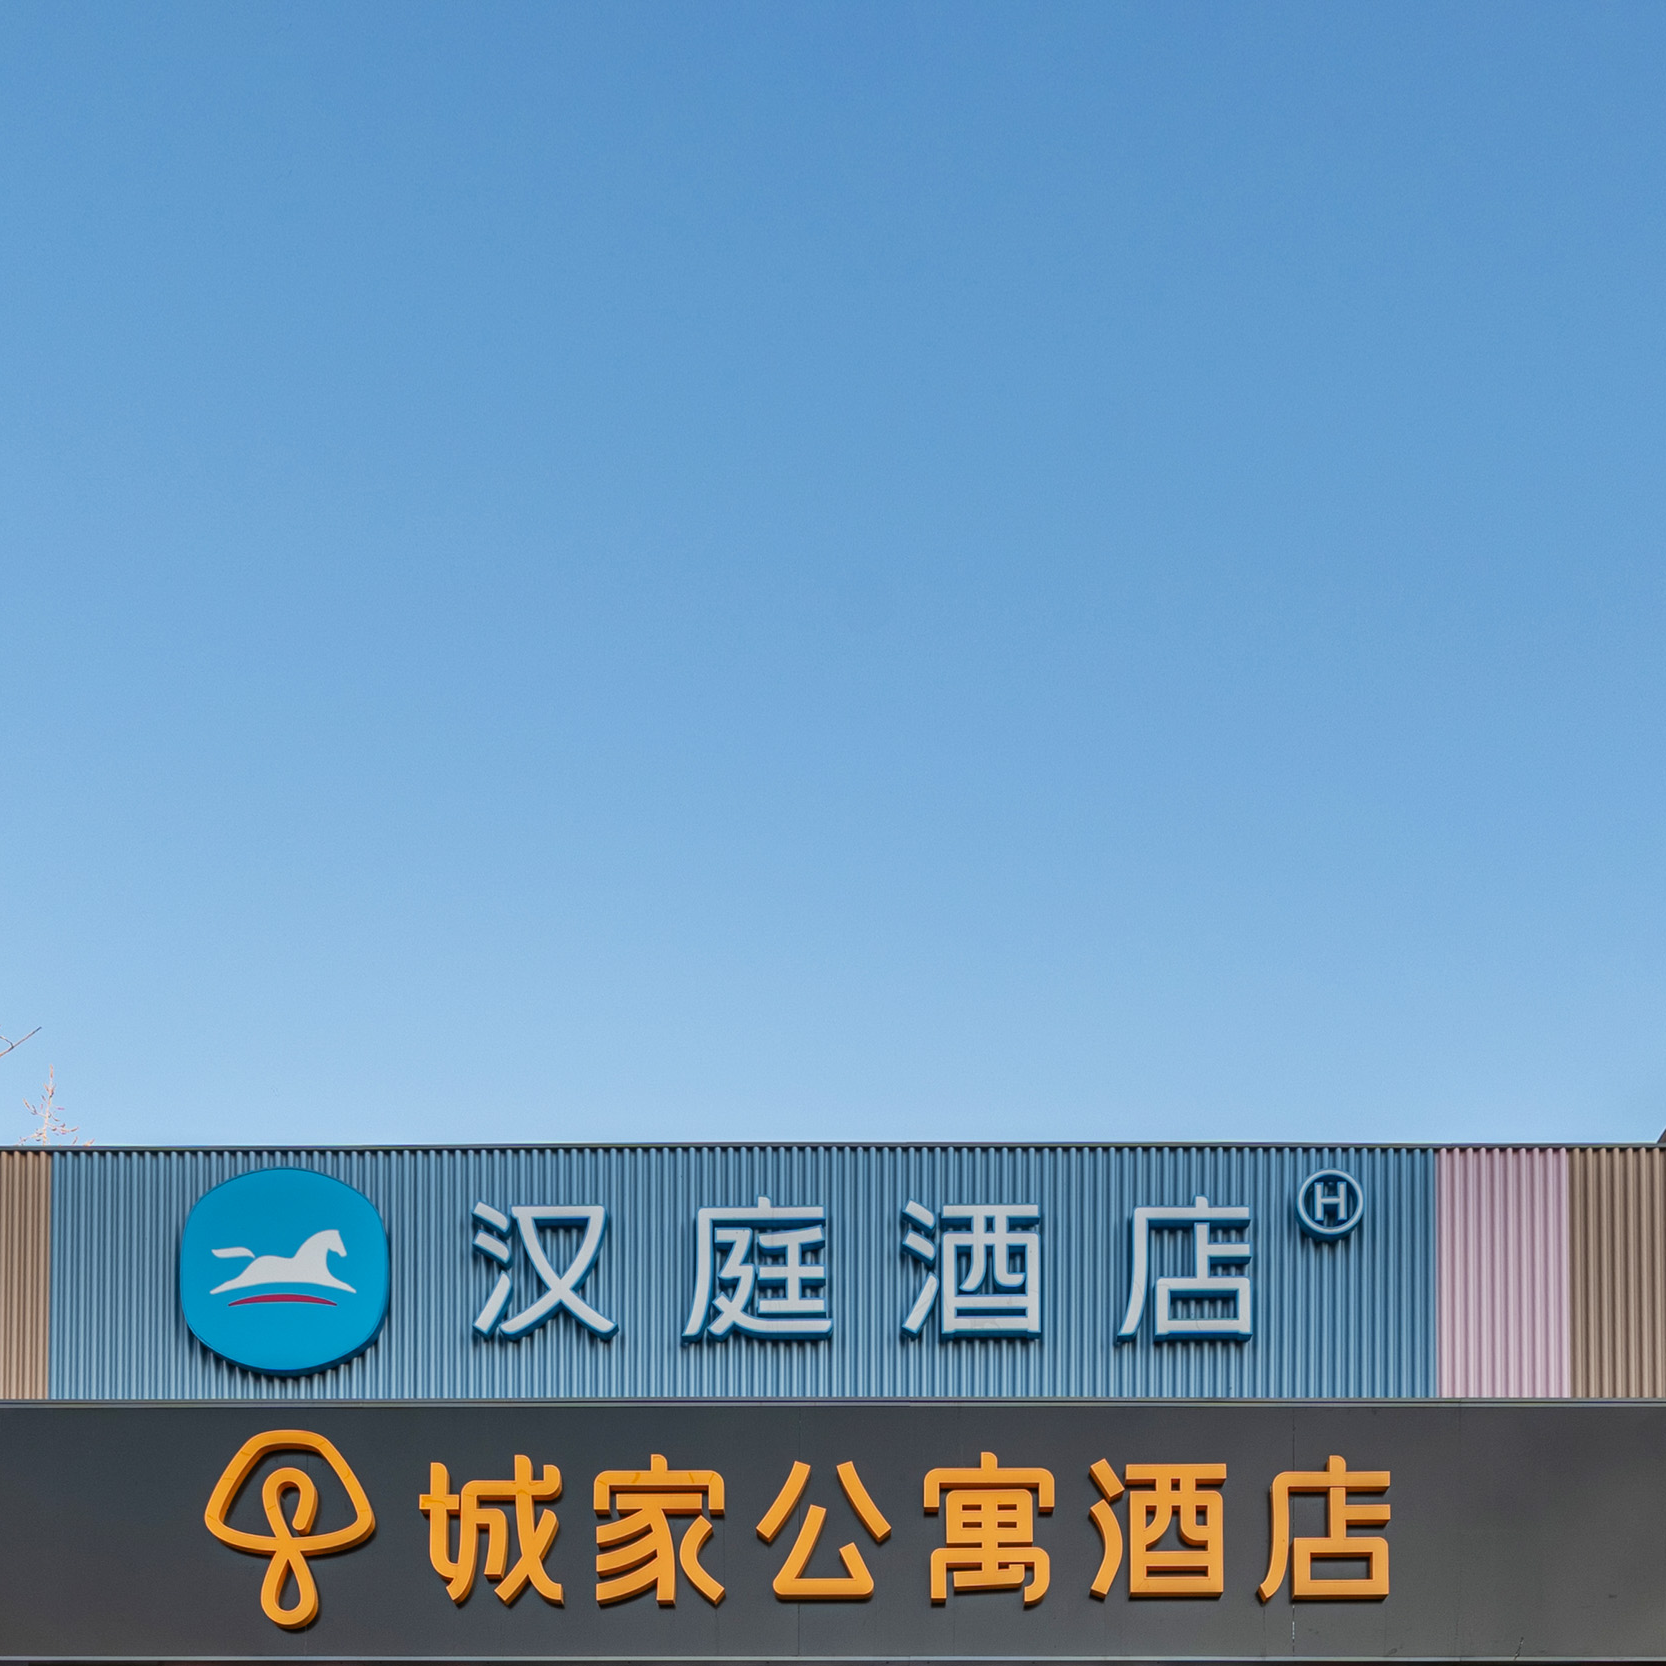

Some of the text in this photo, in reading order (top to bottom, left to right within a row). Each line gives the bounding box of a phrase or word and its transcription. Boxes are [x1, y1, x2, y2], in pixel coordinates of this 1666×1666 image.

[471, 1195, 1255, 1344] 汉庭酒店
[419, 1452, 1391, 1606] 城家公寓酒店
